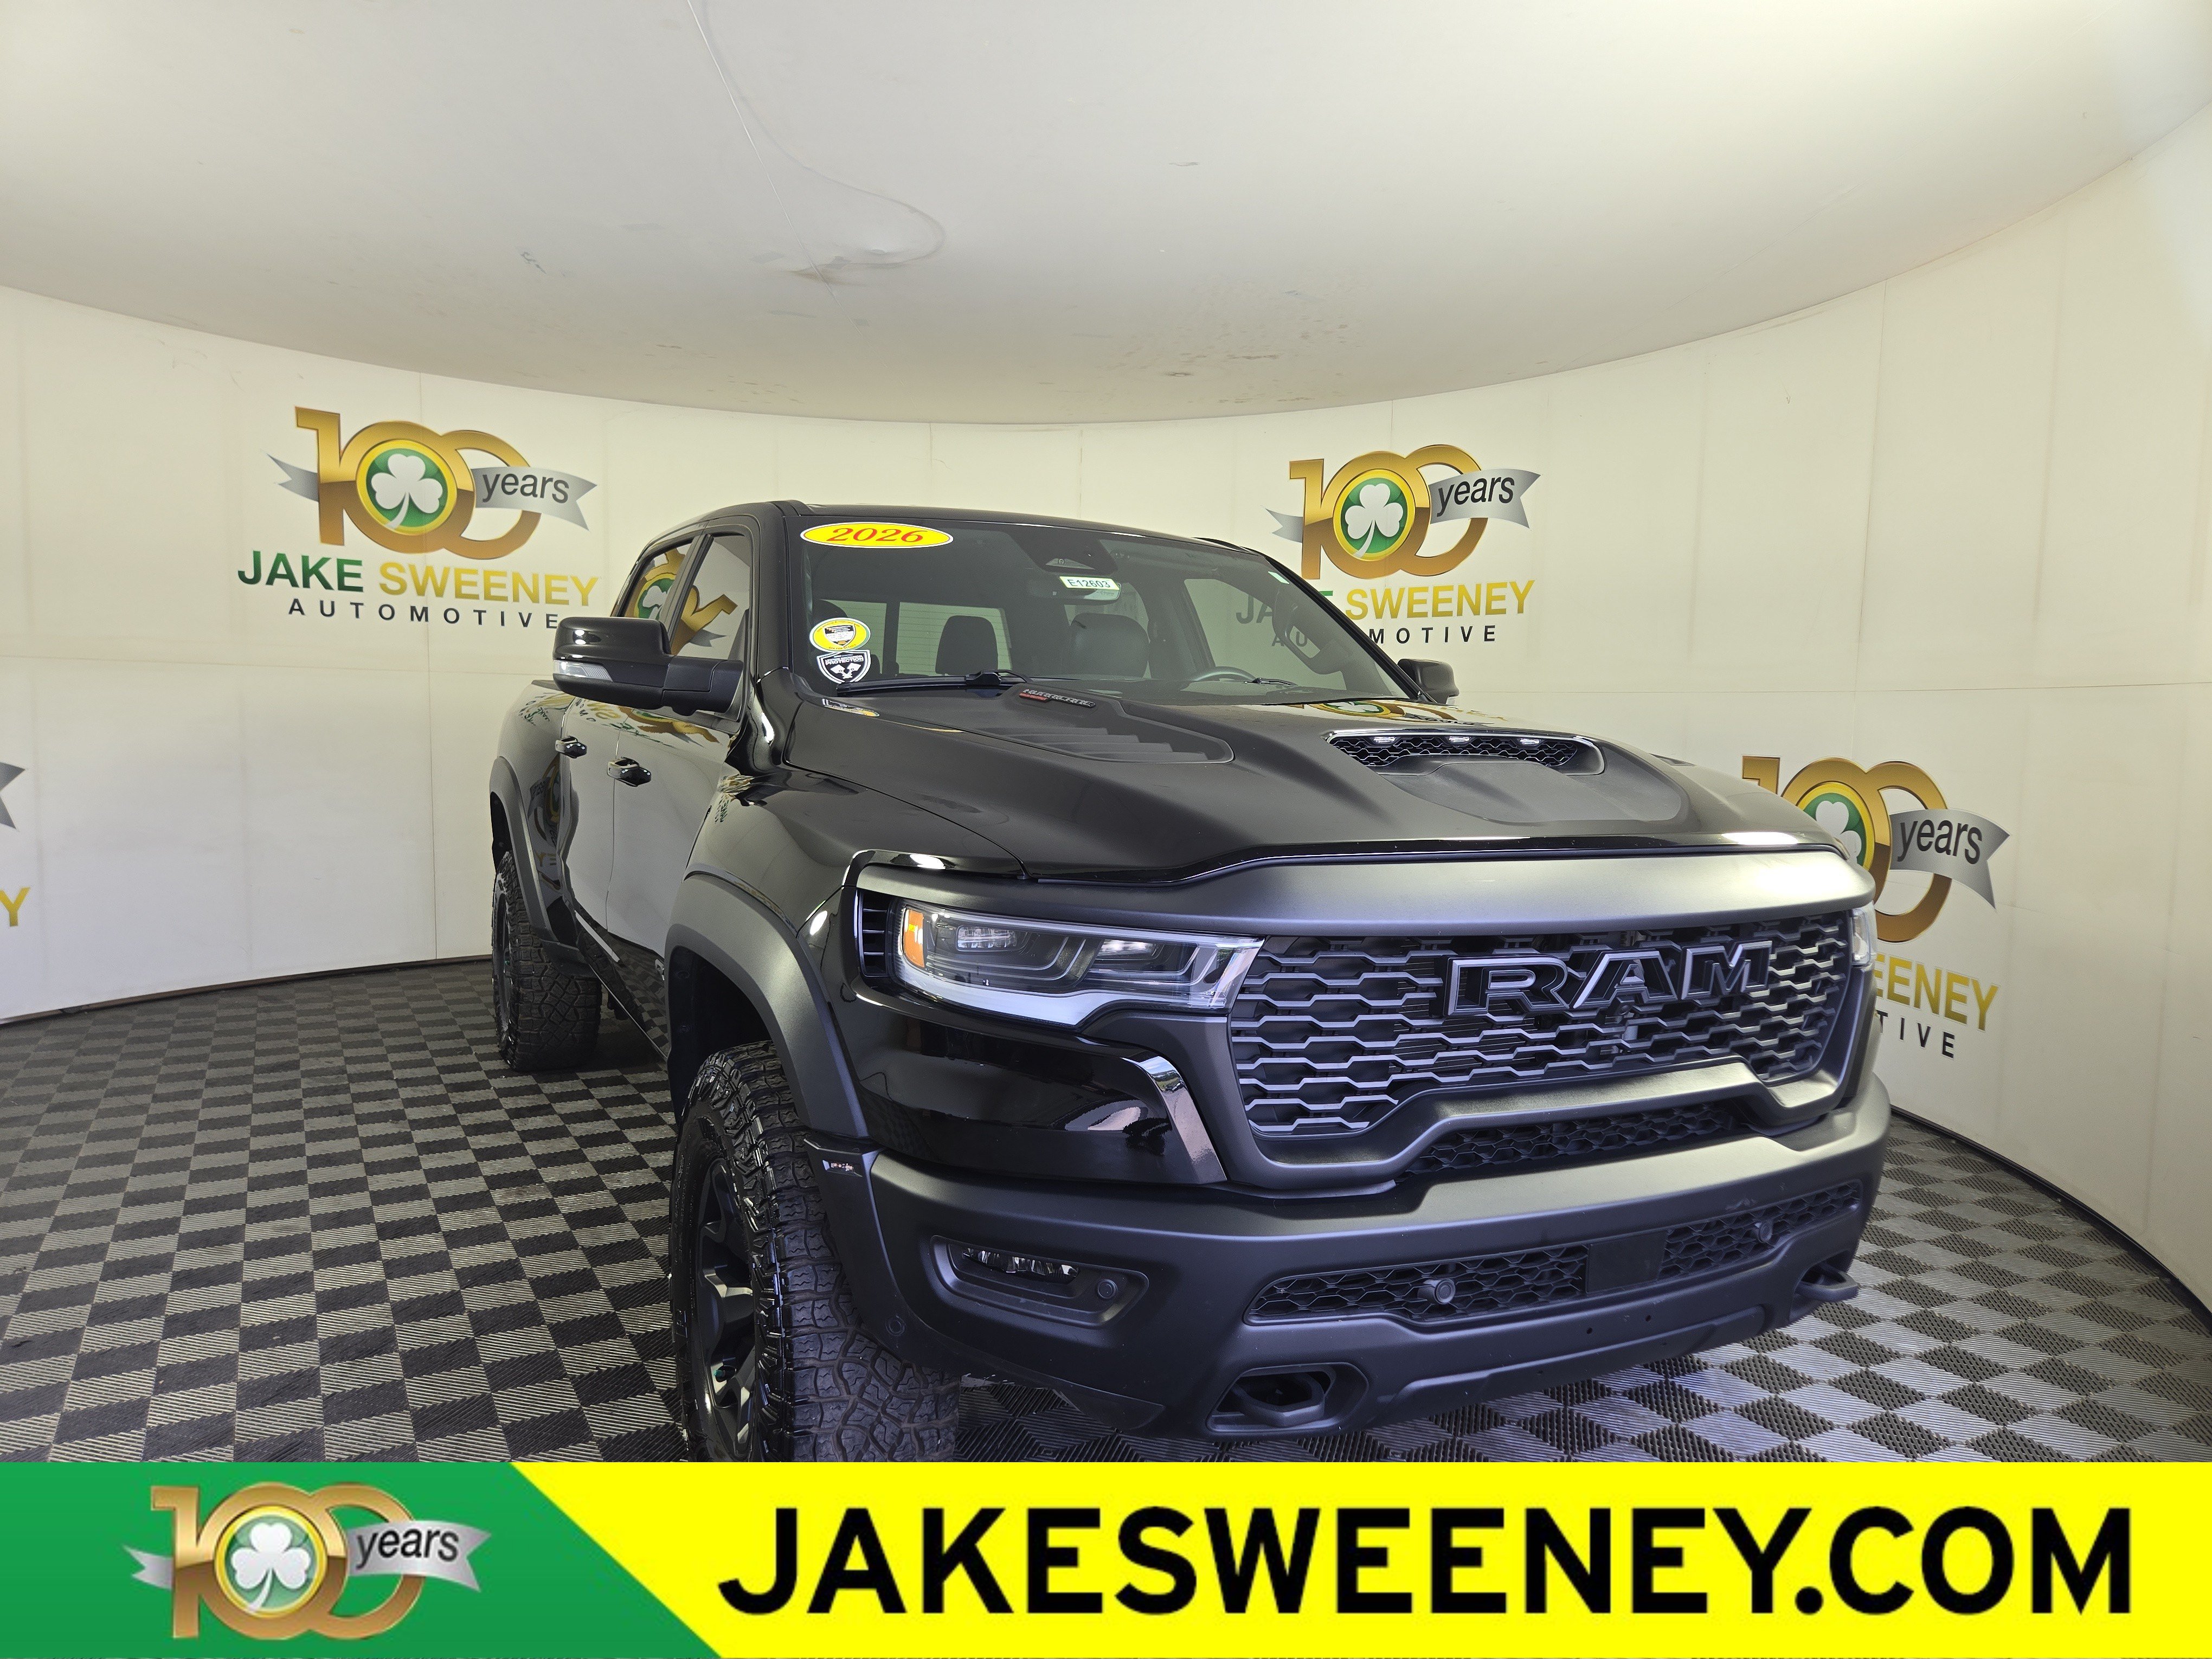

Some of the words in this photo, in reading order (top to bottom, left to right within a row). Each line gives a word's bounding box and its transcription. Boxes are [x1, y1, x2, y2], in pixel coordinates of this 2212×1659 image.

[294, 406, 541, 560] 100
[481, 472, 570, 504] years
[1435, 473, 1515, 518] years
[1289, 444, 1488, 580] 100
[826, 526, 928, 545] 2026
[237, 549, 364, 593] JAKE
[378, 562, 600, 607] SWEENEY
[1066, 578, 1111, 588] E12603
[1345, 580, 1535, 620] SWEENEY
[288, 597, 559, 629] AUTOMOTIVE
[1896, 819, 1983, 865] years
[1446, 940, 1772, 1016] RAM
